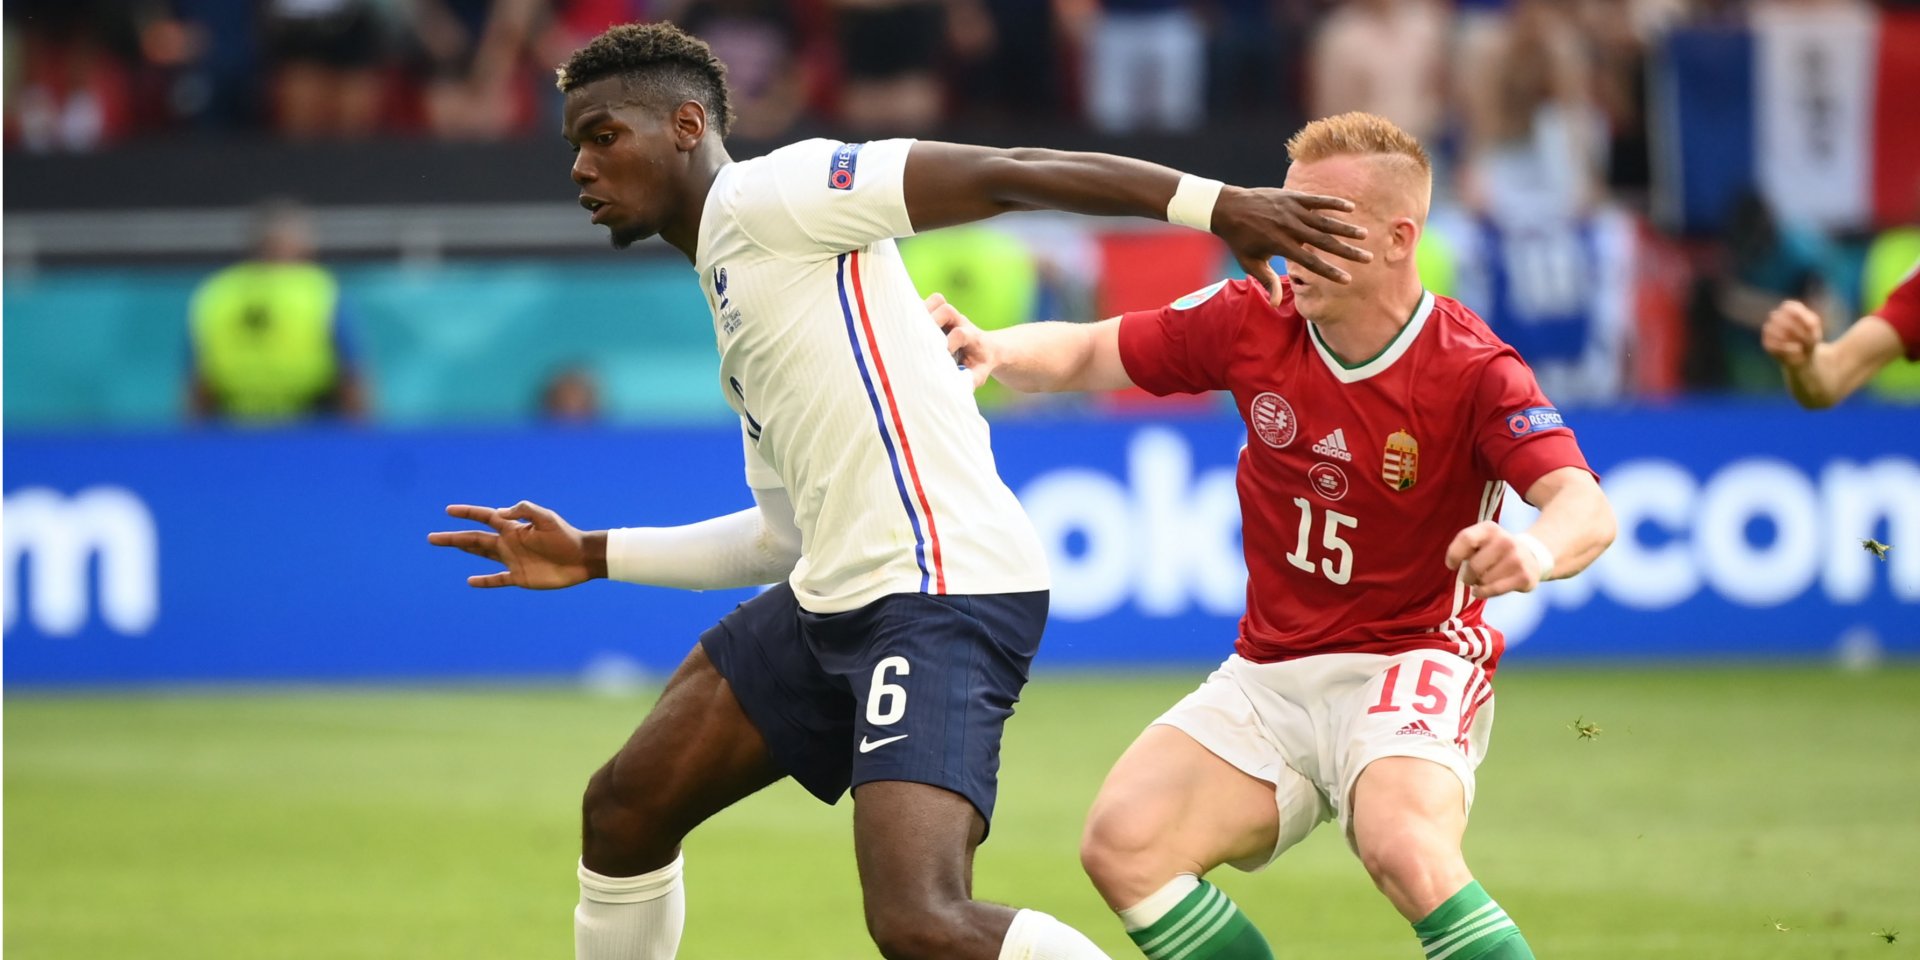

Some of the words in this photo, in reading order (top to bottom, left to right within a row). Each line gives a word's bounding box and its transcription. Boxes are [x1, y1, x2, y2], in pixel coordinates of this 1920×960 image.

[1528, 413, 1564, 426] RESPEC
[1312, 443, 1352, 462] adidas
[1286, 497, 1358, 585] 15
[866, 656, 910, 726] 6
[1367, 659, 1454, 715] 15
[1395, 727, 1438, 739] adidas
